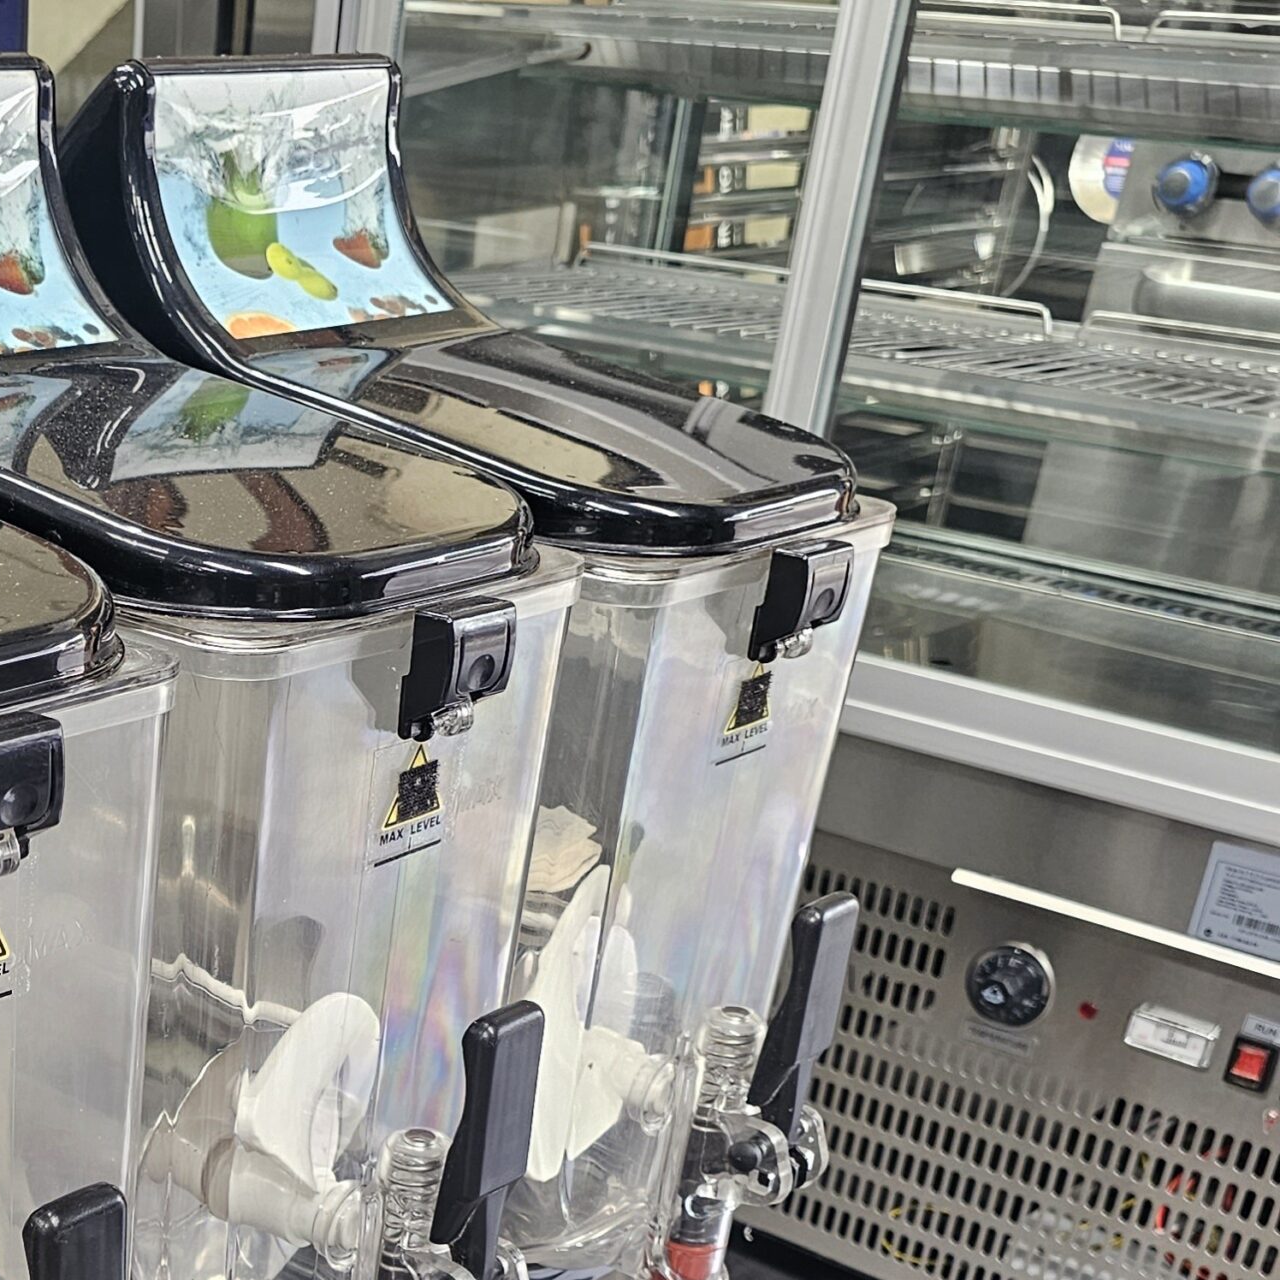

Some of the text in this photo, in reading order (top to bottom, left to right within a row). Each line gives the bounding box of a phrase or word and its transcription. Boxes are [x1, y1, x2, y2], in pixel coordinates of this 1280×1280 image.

[721, 723, 769, 747] MAX LEVEL
[379, 815, 441, 846] MAX LEVEL
